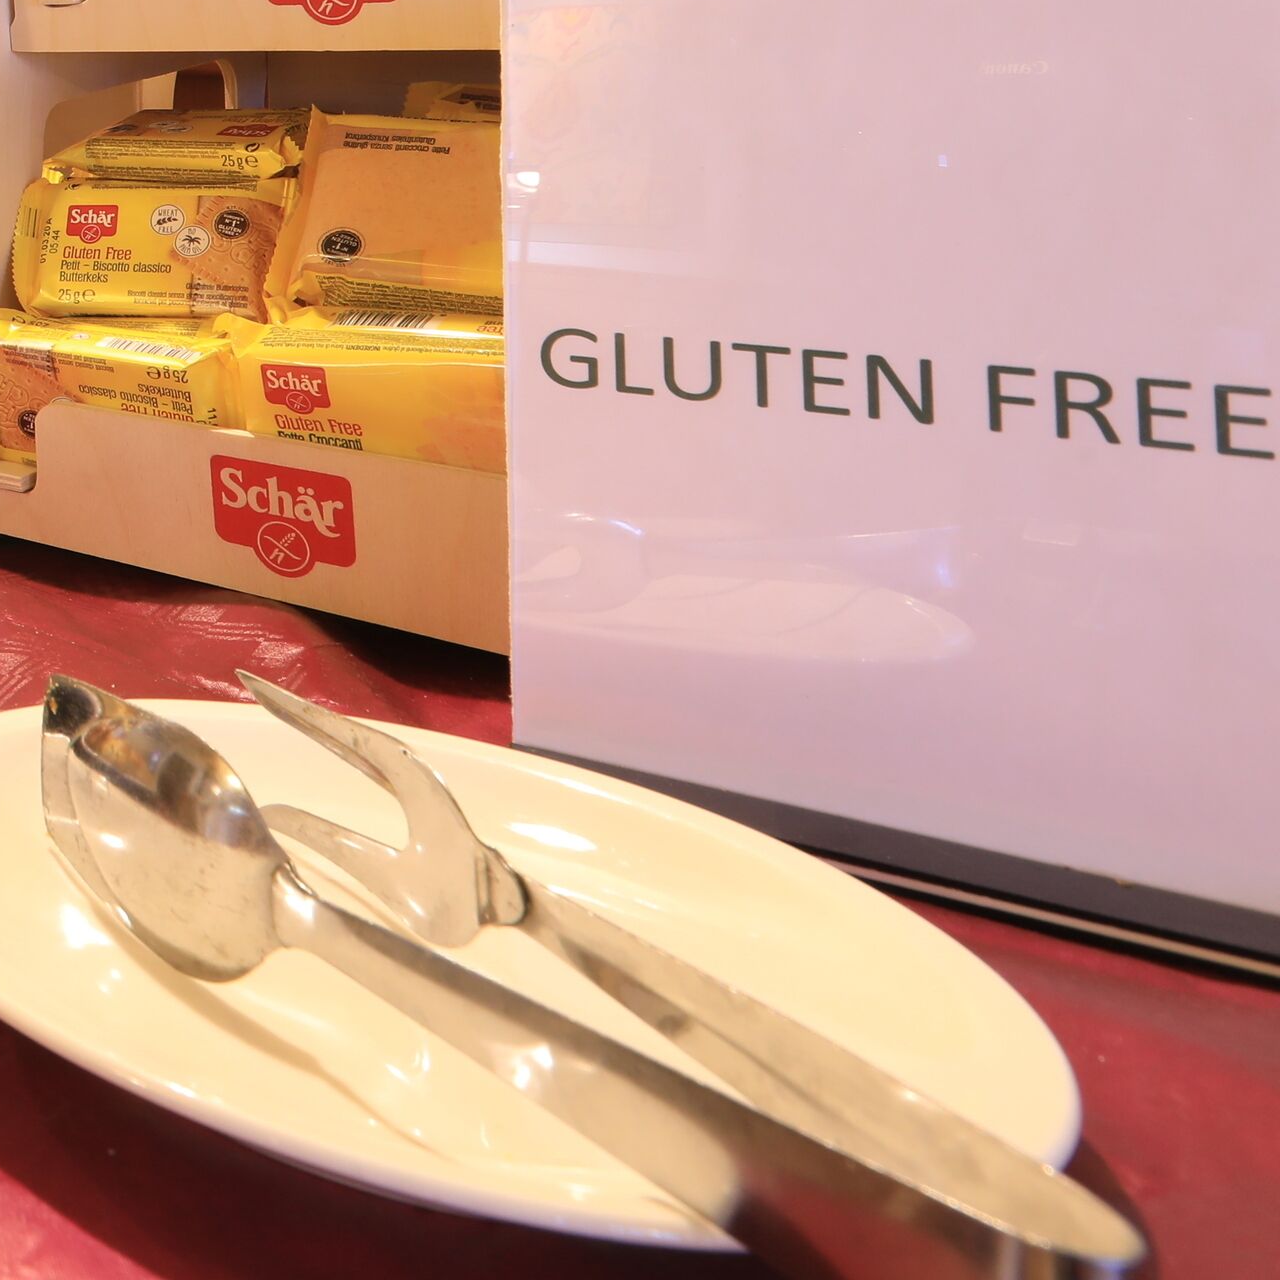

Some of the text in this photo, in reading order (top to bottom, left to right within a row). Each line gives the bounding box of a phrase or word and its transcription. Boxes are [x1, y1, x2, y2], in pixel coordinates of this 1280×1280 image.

[70, 209, 116, 228] Schär
[158, 209, 178, 219] WHEAT
[158, 225, 174, 234] FREE
[218, 223, 243, 234] GLUTEN
[62, 245, 132, 261] Gluten Free
[60, 260, 80, 271] Petit
[92, 261, 130, 273] Biscotto
[133, 262, 172, 274] classico
[59, 271, 108, 284] Butterkeks
[266, 370, 323, 396] Schär
[78, 384, 193, 414] Petit Biscotto classico
[138, 383, 192, 403] Butterkeks
[540, 326, 1278, 462] GLUTEN FREE
[274, 412, 364, 438] Gluten Free
[220, 466, 345, 537] Schär
